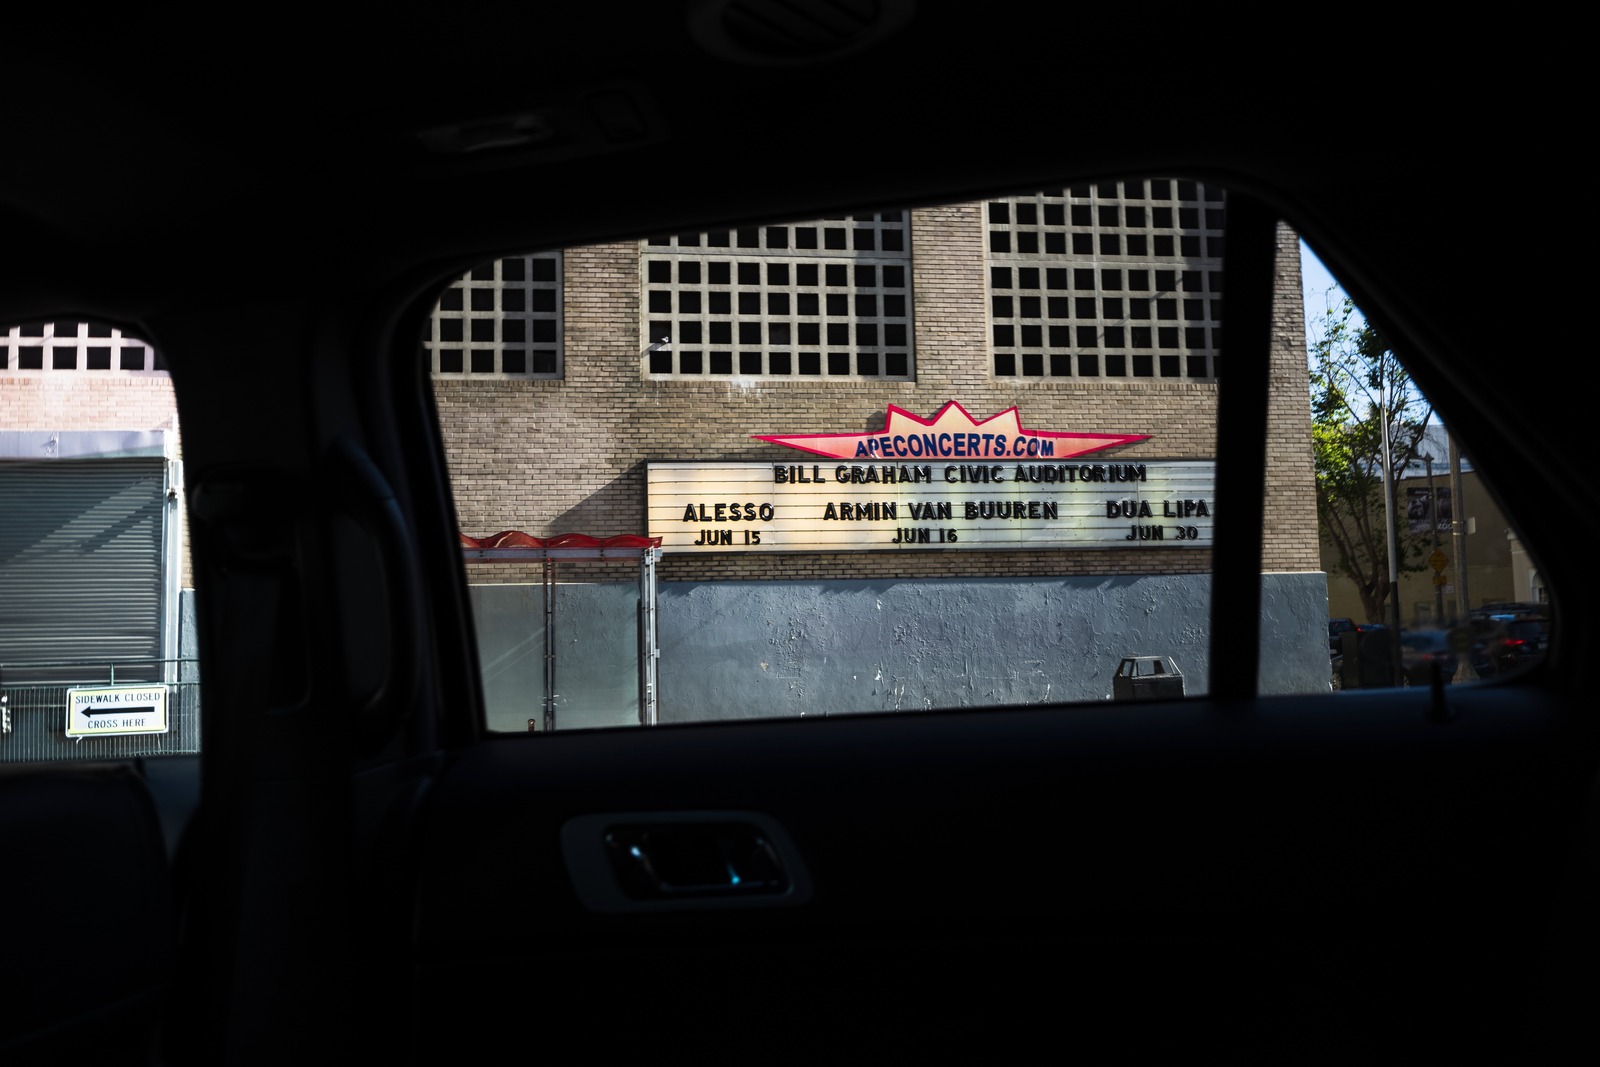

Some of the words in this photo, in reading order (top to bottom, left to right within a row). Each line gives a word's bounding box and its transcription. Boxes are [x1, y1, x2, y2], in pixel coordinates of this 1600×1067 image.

[856, 433, 1054, 457] APECONCERTS.COM
[774, 465, 826, 484] BILL
[835, 465, 932, 484] GRAHAM
[944, 464, 1005, 484] CIVIC
[1014, 464, 1147, 483] AUDITORIUM
[683, 503, 775, 522] ALESSO
[823, 502, 897, 521] ARMIN
[907, 501, 952, 520] VAN
[964, 501, 1058, 520] BUUREN
[1106, 500, 1153, 519] DUA
[1163, 499, 1211, 518] LIPA
[694, 529, 732, 546] JUN
[744, 530, 761, 545] 15
[892, 527, 930, 544] JUN
[939, 528, 958, 544] 16
[1126, 525, 1164, 541] JUN
[1175, 525, 1199, 541] 30
[76, 694, 120, 704] SIDEWALK
[125, 692, 161, 702] CLOSED
[87, 719, 118, 729] CROSS
[122, 718, 146, 727] HERE
